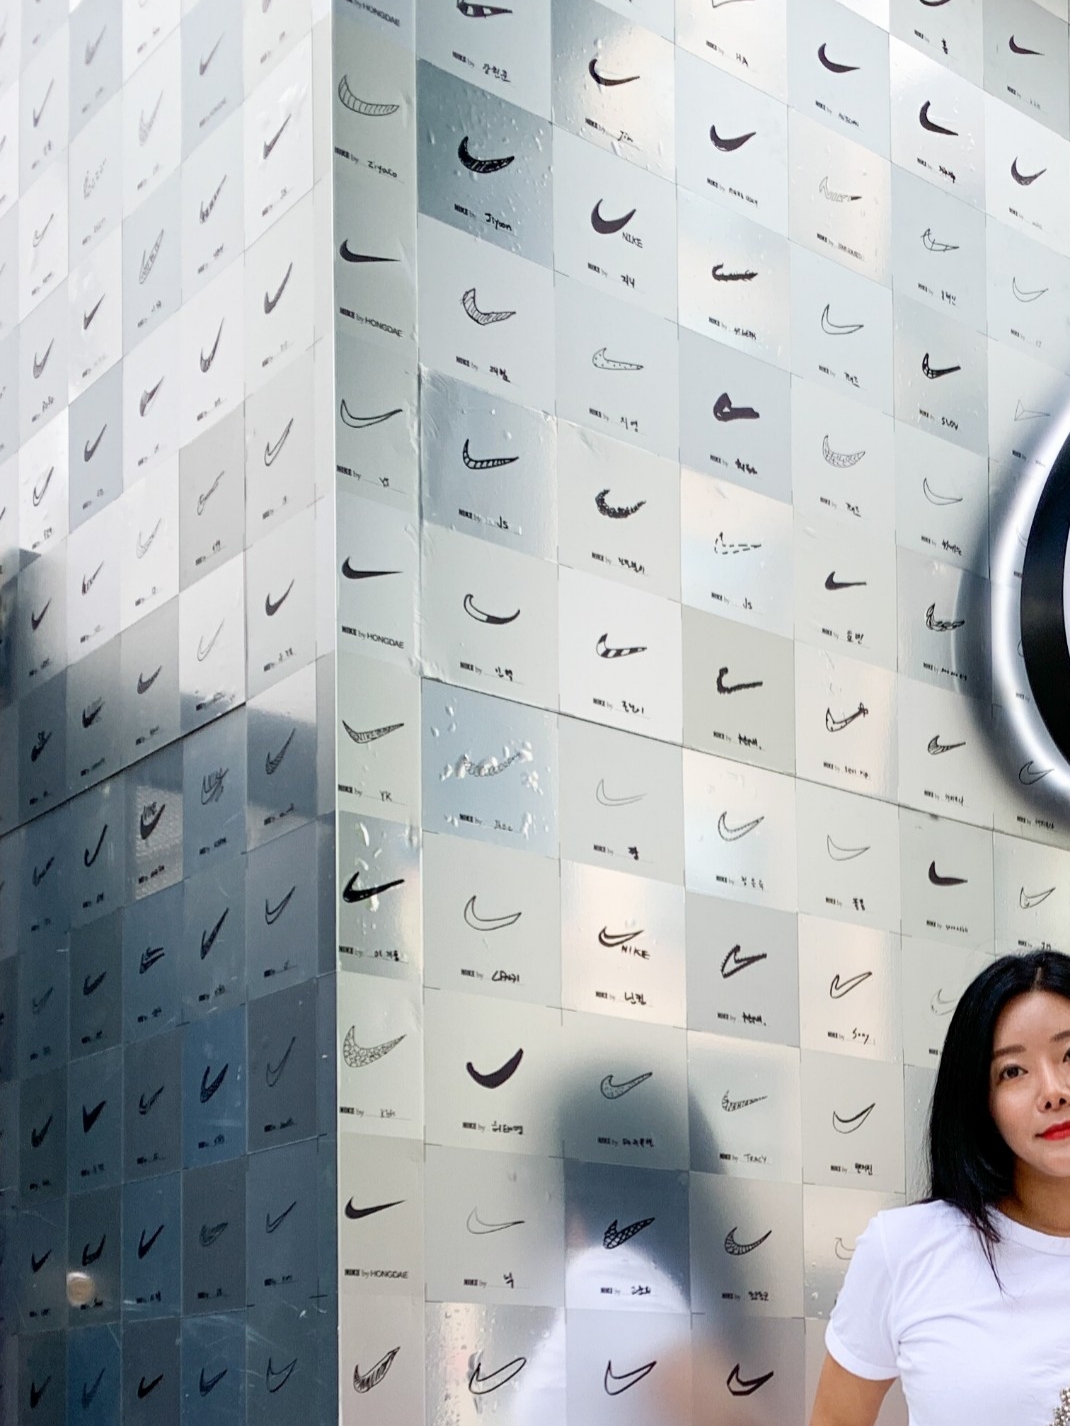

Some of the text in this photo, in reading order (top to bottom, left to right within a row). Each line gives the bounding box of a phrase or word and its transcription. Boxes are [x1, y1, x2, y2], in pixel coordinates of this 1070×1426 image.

[453, 51, 466, 63] NIKE
[334, 146, 350, 159] NIKE
[454, 204, 468, 216] NIKE
[622, 232, 643, 248] NIKE
[340, 307, 355, 319] NIKE
[365, 317, 402, 337] HONGDAE
[456, 356, 469, 367] NIKE
[336, 465, 352, 476] NIKE
[459, 509, 472, 519] NIKE
[342, 626, 357, 636] NIKE
[367, 633, 404, 648] HONGDAE
[460, 662, 473, 671] NIKE
[338, 784, 353, 793] NIKE
[460, 814, 473, 823] NIKE
[339, 946, 353, 955] NIKE
[621, 945, 650, 960] NIKE
[461, 969, 474, 977] NIKE
